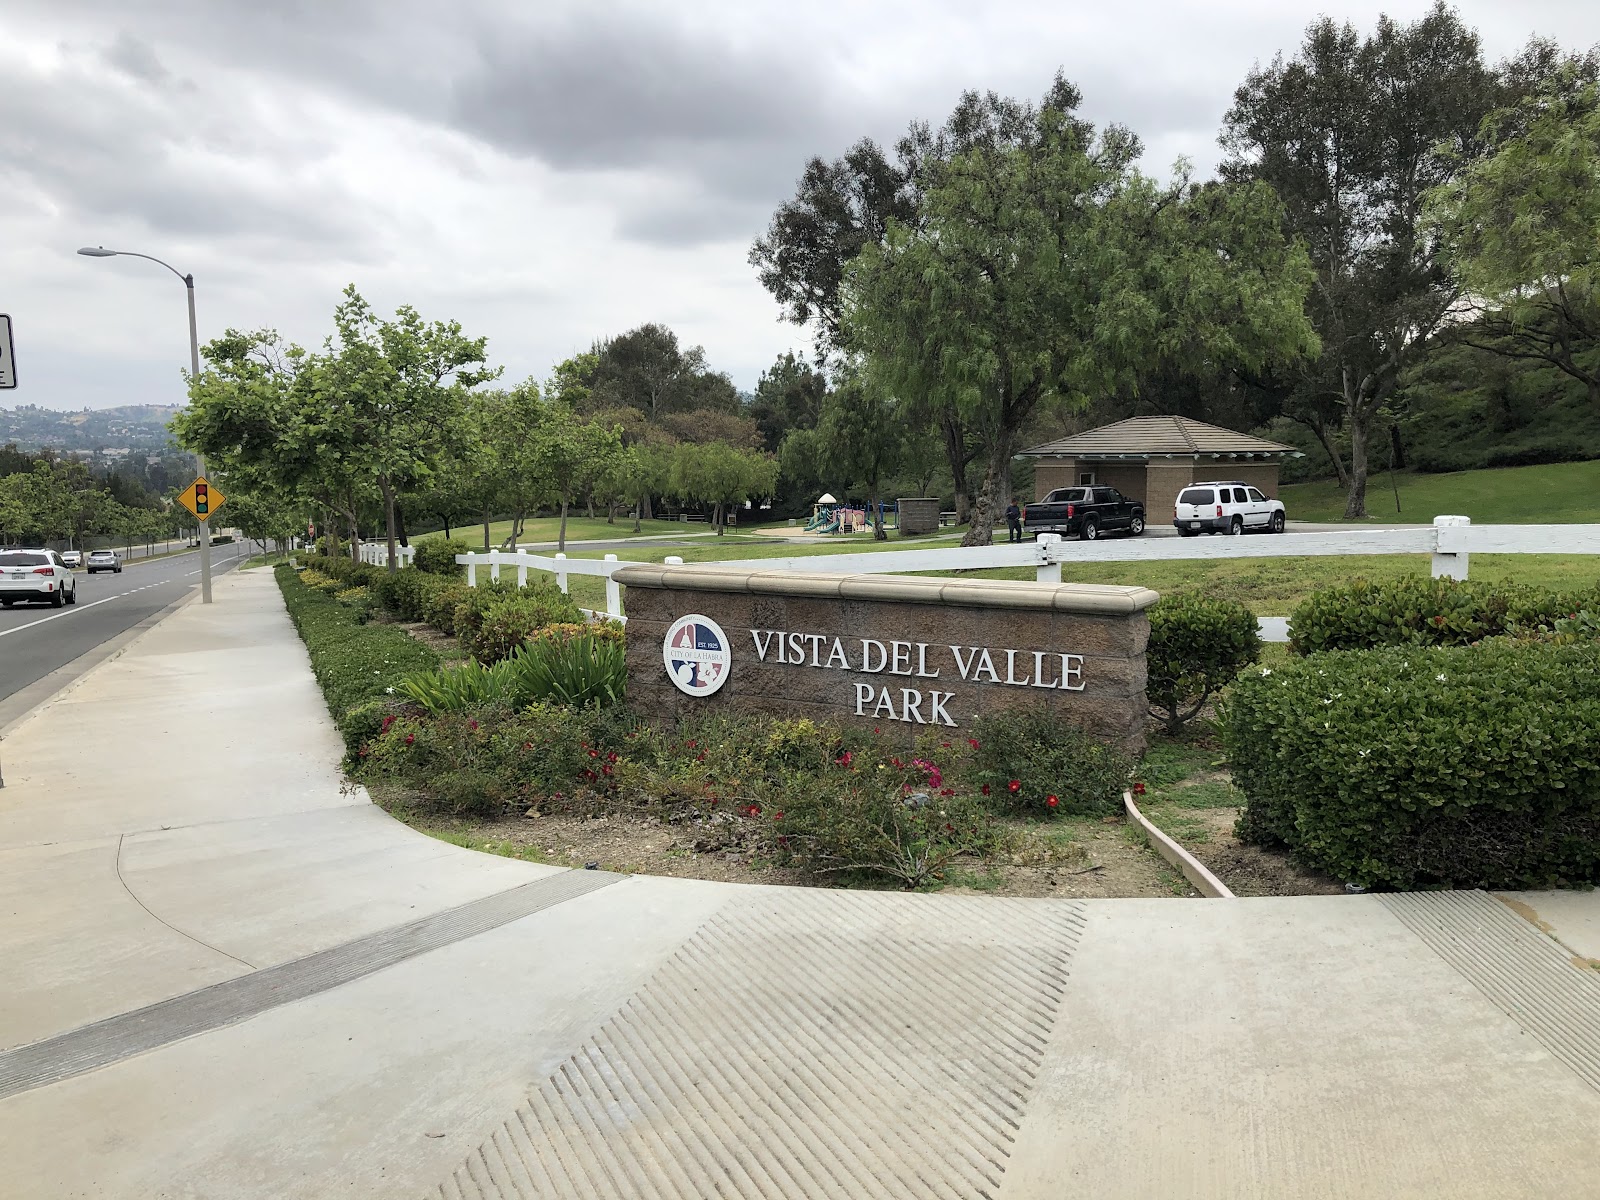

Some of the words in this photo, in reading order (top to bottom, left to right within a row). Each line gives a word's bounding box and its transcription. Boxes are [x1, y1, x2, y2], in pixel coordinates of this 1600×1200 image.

[670, 650, 684, 658] CITY
[702, 652, 723, 661] HABRA
[750, 629, 852, 670] VISTA
[860, 639, 940, 678] DEL
[949, 645, 1086, 692] VALLE
[853, 683, 959, 728] PARK
